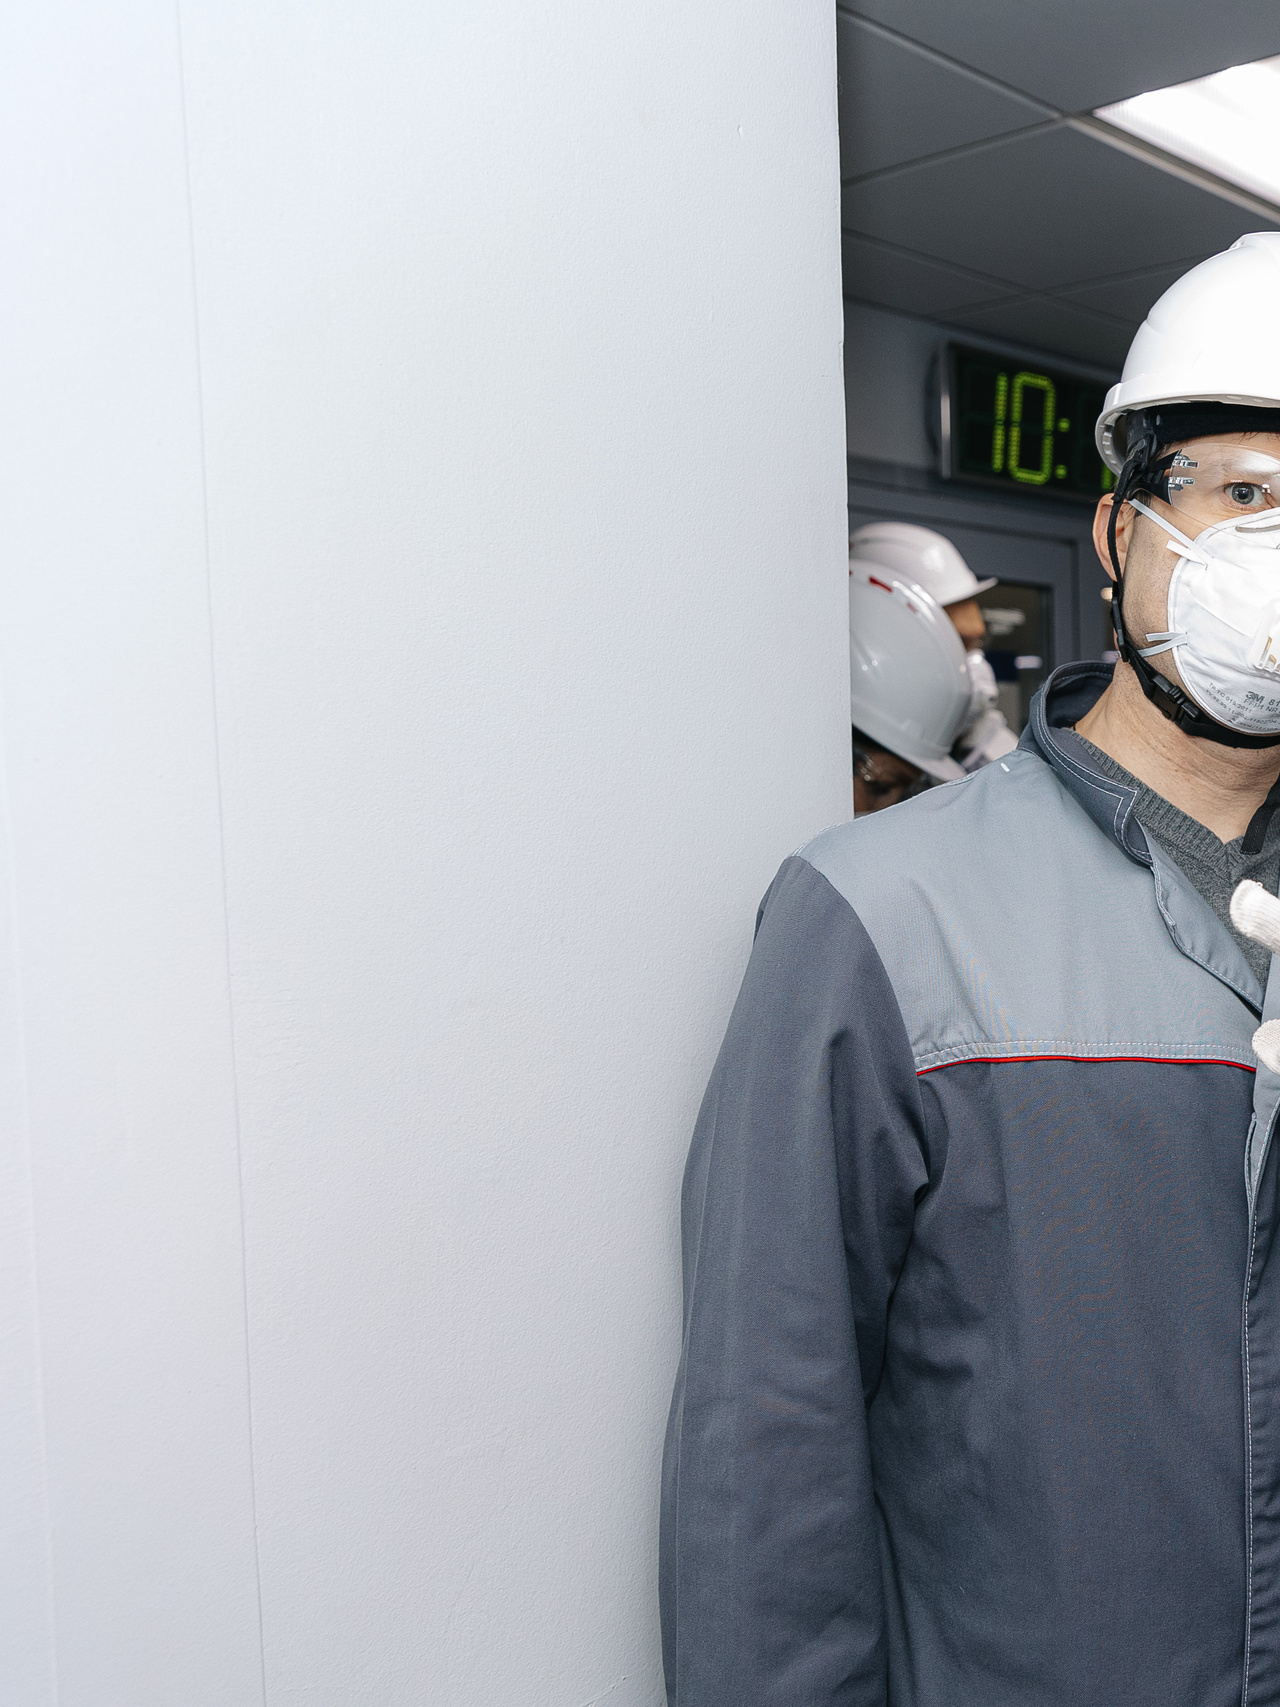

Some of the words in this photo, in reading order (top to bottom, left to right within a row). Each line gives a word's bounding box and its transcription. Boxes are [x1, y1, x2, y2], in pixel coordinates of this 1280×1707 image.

[992, 371, 1115, 489] 10:
[1243, 698, 1265, 710] FFP1
[1246, 691, 1265, 704] 3M
